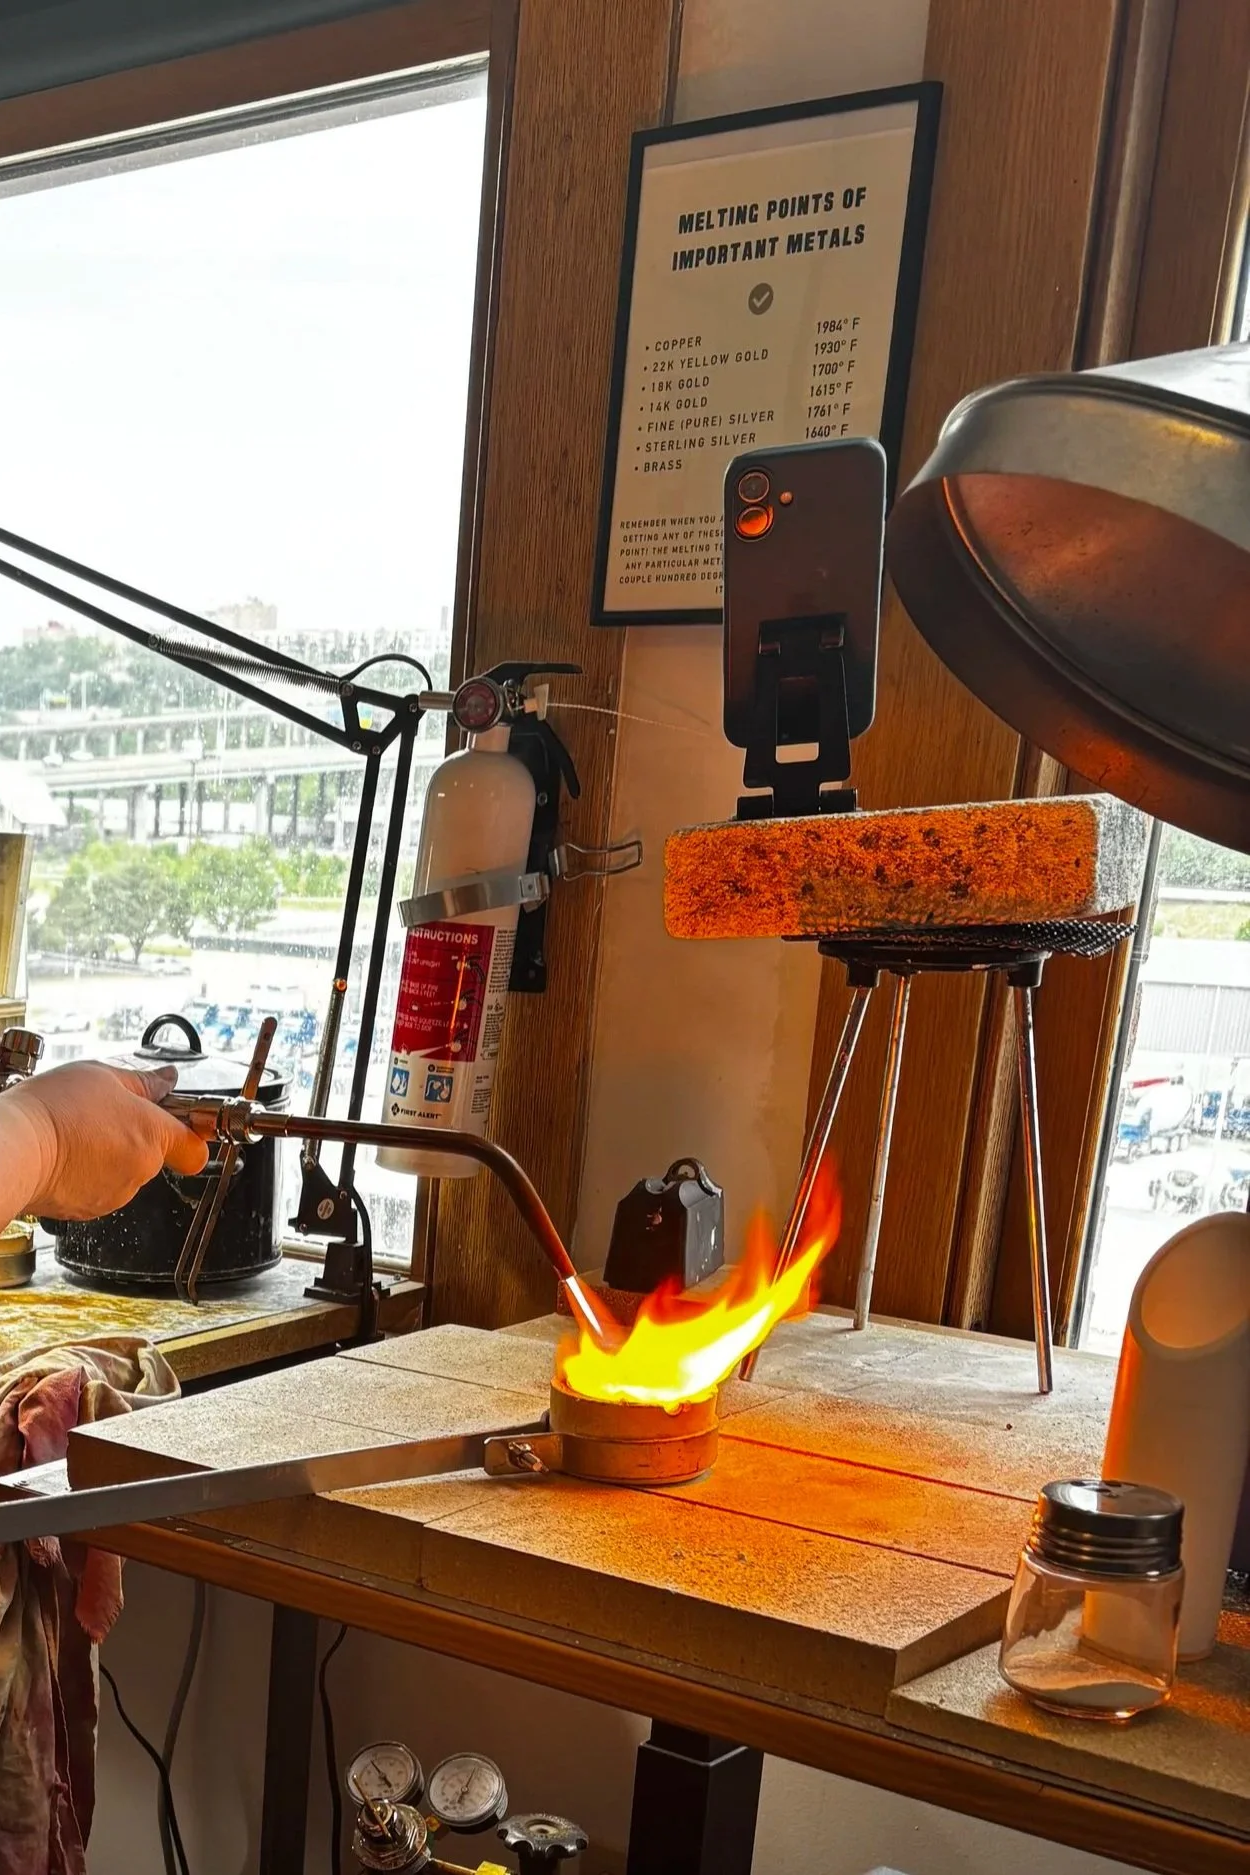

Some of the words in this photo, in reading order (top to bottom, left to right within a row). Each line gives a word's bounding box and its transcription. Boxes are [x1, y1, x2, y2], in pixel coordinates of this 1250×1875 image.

[678, 203, 759, 234] MELTING
[766, 191, 834, 220] POINTS
[842, 187, 867, 209] OF
[672, 236, 779, 271] IMPORTANT
[786, 224, 865, 254] METALS
[817, 318, 848, 334] 1984°
[852, 317, 861, 330] F
[654, 336, 702, 351] COPPER
[814, 339, 846, 356] 1930°
[850, 339, 858, 352] F
[652, 360, 674, 372] 22K
[680, 353, 729, 369] YELLOW
[735, 349, 768, 363] GOLD
[812, 361, 844, 377] 1700°
[847, 360, 855, 373] F
[651, 380, 672, 392] 18K
[678, 376, 710, 390] GOLD
[810, 382, 842, 397] 1615°
[845, 381, 853, 394] F
[650, 401, 670, 413] 14K
[676, 396, 708, 410] GOLD
[808, 403, 839, 419] 1761°
[843, 403, 851, 416] F
[647, 420, 675, 432] FINE
[680, 415, 722, 430] (PURE)
[729, 410, 774, 425] SILVER
[805, 424, 837, 439] 1640°
[840, 423, 849, 436] F
[645, 437, 705, 452] STERLING
[711, 432, 756, 446] SILVER
[644, 459, 682, 472] BRASS
[620, 518, 667, 529] REMEMBER
[670, 517, 695, 526] WHEN
[699, 515, 716, 524] YOU
[622, 533, 659, 543] GETTING
[662, 532, 679, 540] ANY
[683, 531, 695, 539] OF
[652, 546, 668, 555] THE
[672, 543, 710, 554] MELTING
[625, 562, 642, 570] ANY
[645, 558, 699, 569] PARTICULAR
[703, 557, 723, 565] MET
[619, 574, 652, 584] COUPLE
[655, 572, 697, 582] HUNDRED
[400, 1108, 416, 1117] FIRST
[418, 1111, 440, 1119] ALERT
